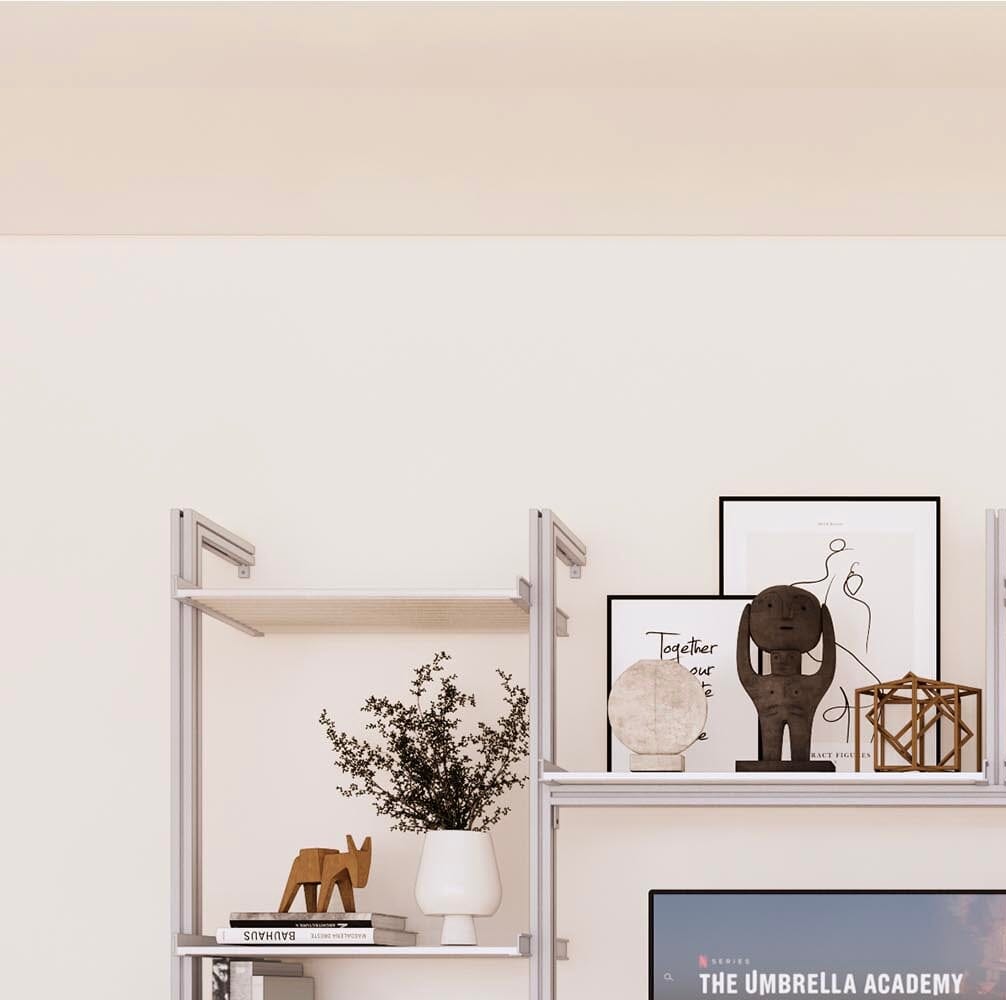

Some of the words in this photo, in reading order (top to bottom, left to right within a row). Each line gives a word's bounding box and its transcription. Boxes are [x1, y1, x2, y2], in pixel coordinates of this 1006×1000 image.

[645, 631, 719, 664] Together
[244, 931, 296, 940] BAUHAUS
[711, 958, 751, 966] SERIES
[698, 971, 738, 994] THE
[745, 969, 856, 996] UMBRELLA
[864, 973, 964, 996] ACADEMY
